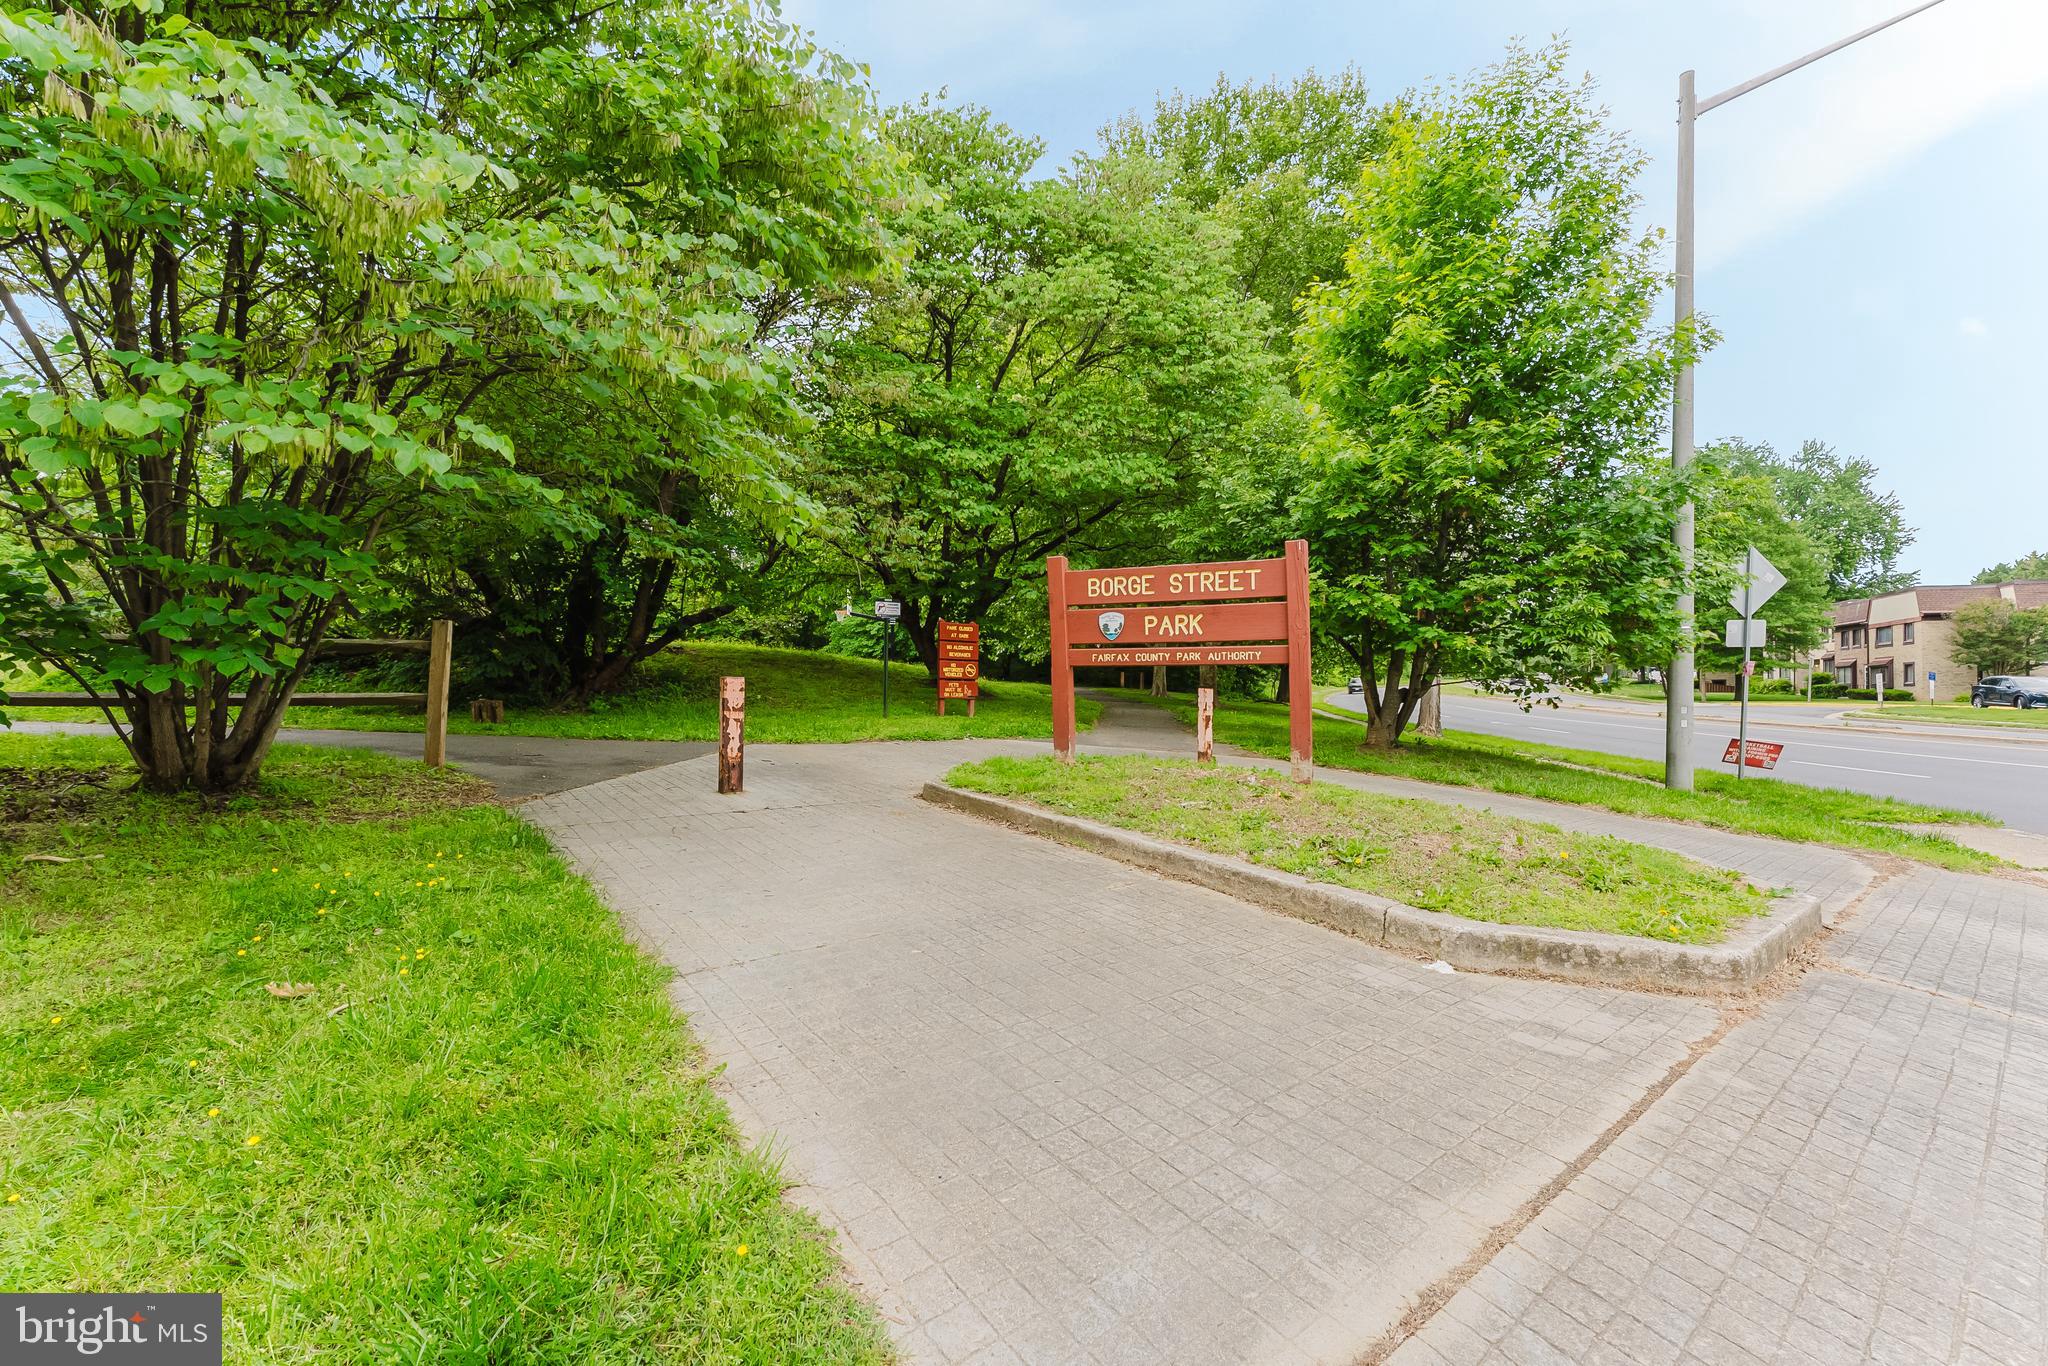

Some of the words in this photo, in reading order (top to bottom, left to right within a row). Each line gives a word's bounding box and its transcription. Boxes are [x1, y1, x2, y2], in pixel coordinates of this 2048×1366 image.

[1088, 575, 1155, 597] BORGE
[1169, 569, 1262, 594] STREET
[1144, 613, 1204, 637] PARK
[1092, 653, 1130, 662] FAIRFAX
[1135, 652, 1170, 662] COUNTY
[1176, 652, 1201, 662] PARK
[1207, 651, 1262, 661] AUTHORITY
